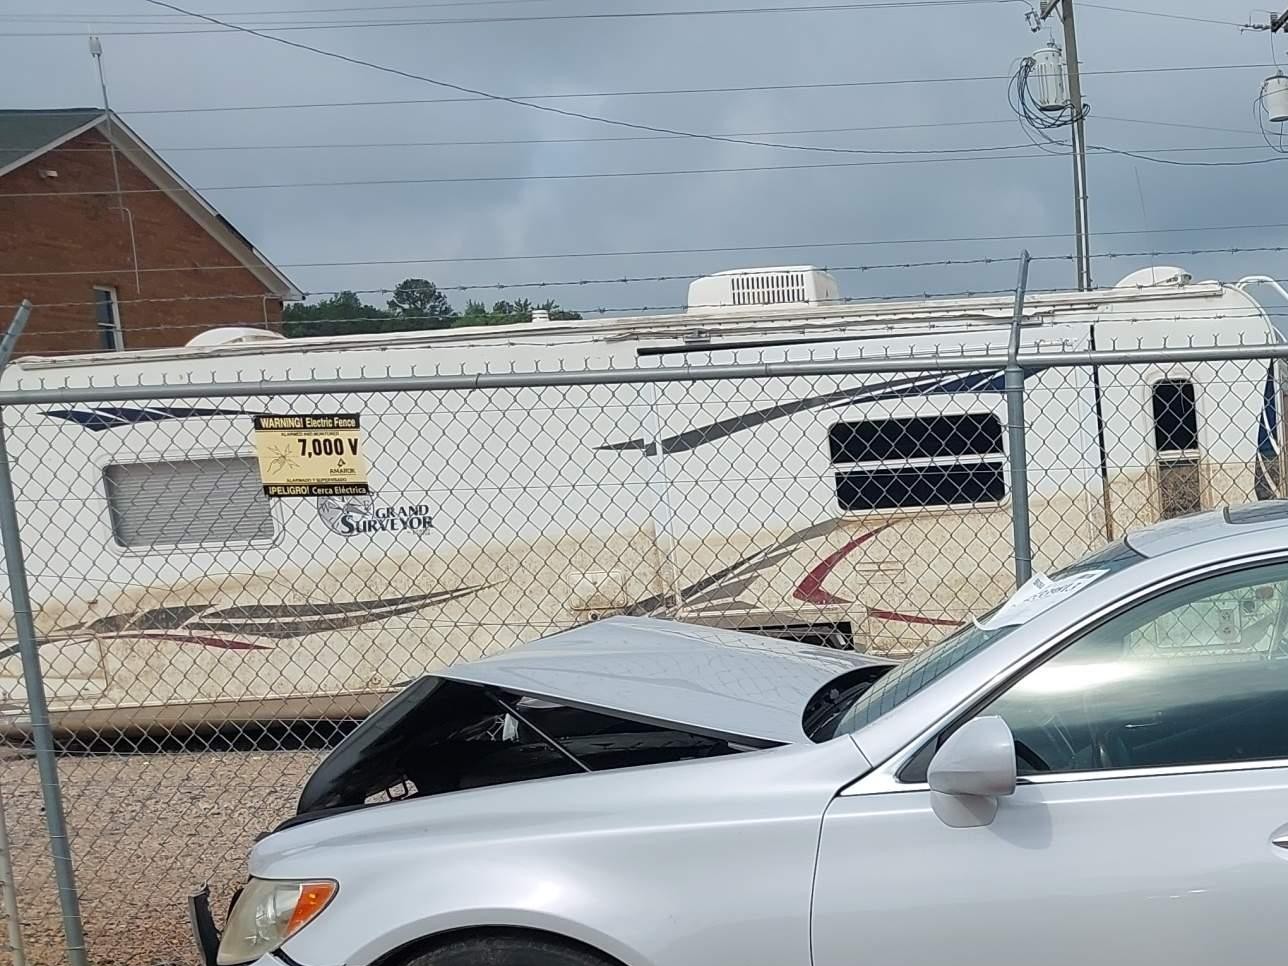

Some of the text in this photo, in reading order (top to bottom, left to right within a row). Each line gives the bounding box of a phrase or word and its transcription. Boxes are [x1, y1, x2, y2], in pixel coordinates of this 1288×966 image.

[260, 416, 356, 429] WARNING! Electric Fence
[298, 438, 358, 459] 7,000 V
[269, 485, 366, 495] ¡PELIGRO! Cerca Eléctrica
[375, 504, 429, 519] GRAND
[341, 514, 433, 534] SURVEYOR
